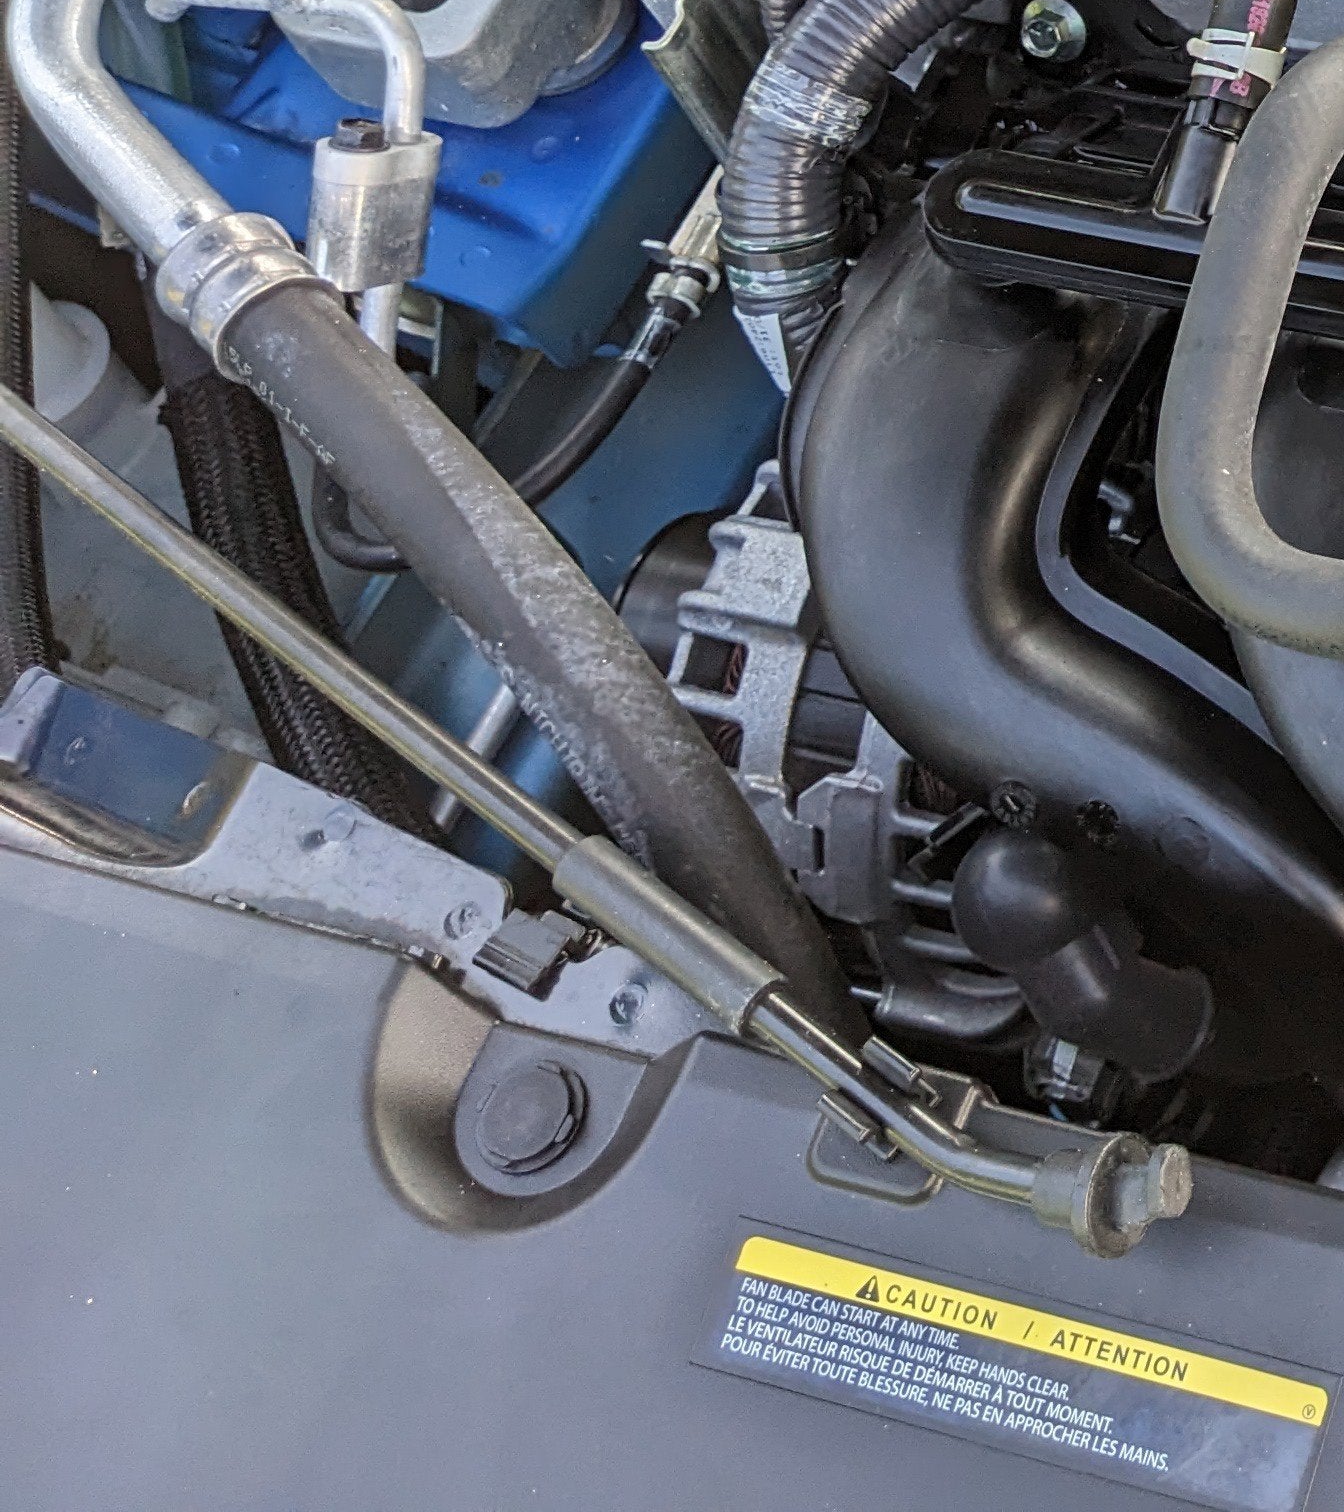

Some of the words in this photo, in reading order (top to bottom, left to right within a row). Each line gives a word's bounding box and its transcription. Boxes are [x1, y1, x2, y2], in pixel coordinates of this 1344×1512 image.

[735, 1297, 755, 1316] TO
[753, 1301, 790, 1325] HELP
[787, 1310, 830, 1335] AVOID
[830, 1321, 898, 1353] PERSONAL
[896, 1339, 945, 1369] INJURY,
[945, 1352, 979, 1376] KEEP
[978, 1361, 1027, 1389] HANDS
[1026, 1374, 1071, 1401] CLEAR.
[740, 1277, 769, 1301] FAN
[767, 1284, 811, 1309] BLADE
[810, 1295, 840, 1317] CAN
[839, 1303, 882, 1329] START
[880, 1314, 899, 1333] AT
[884, 1283, 998, 1330] CAUTION
[1049, 1327, 1189, 1382] ATTENTION
[720, 1333, 760, 1357] POUR
[762, 1342, 811, 1371] ÉVITER
[809, 1358, 857, 1384] TOUTE
[856, 1370, 932, 1406] BLESSURE,
[931, 1390, 953, 1410] NE
[952, 1396, 981, 1418] PAS
[981, 1404, 1004, 1424] EN
[1003, 1410, 1092, 1448] APPROCHER
[1092, 1435, 1119, 1455] LES
[1118, 1442, 1171, 1470] MAINS.
[727, 1314, 746, 1333] LE
[744, 1319, 839, 1359] VENTILATEUR
[837, 1344, 891, 1373] RISQUE
[890, 1358, 913, 1378] DE
[912, 1361, 993, 1400] DÉMARRER
[991, 1383, 1005, 1403] À
[1004, 1389, 1046, 1415] TOUT
[1045, 1402, 1115, 1434] MOMENT.
